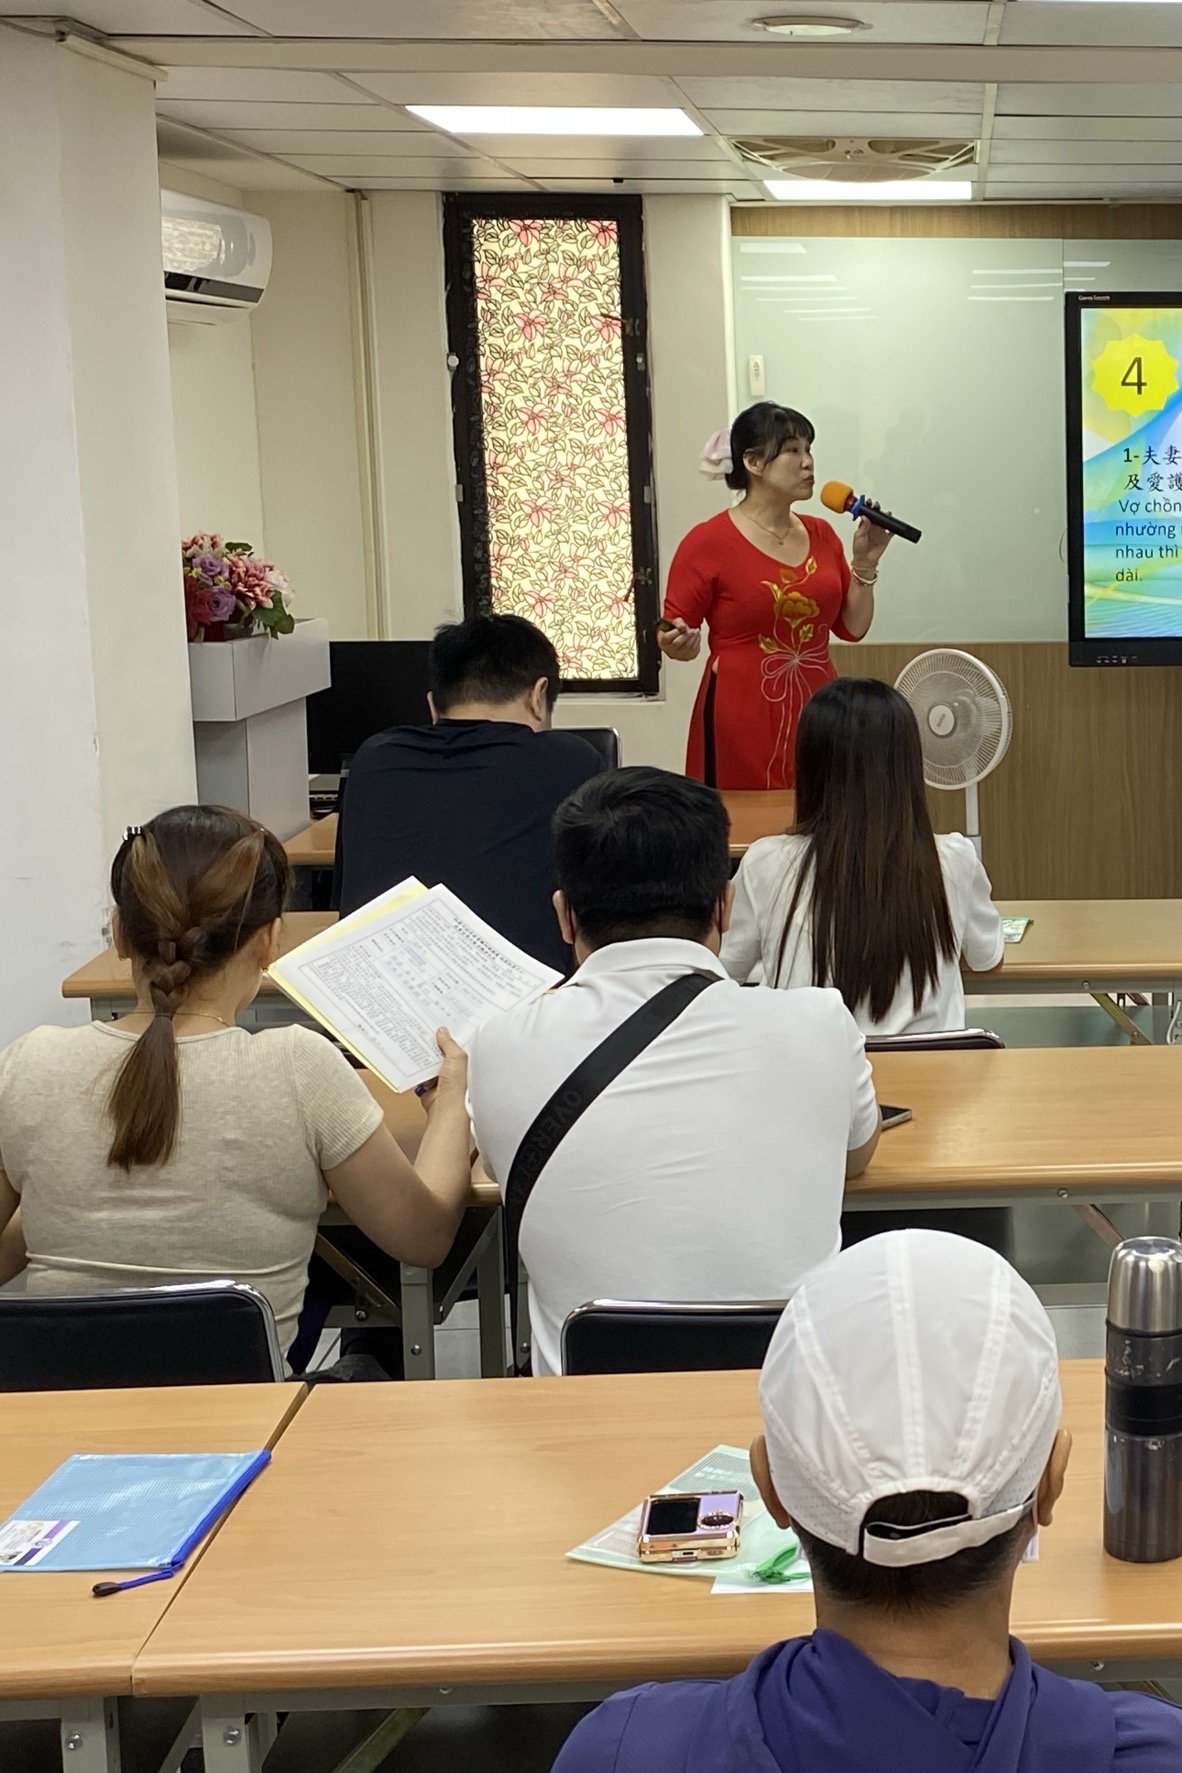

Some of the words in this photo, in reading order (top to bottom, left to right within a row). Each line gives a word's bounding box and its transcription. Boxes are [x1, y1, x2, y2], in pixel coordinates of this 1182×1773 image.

[1120, 356, 1148, 395] 4
[1118, 499, 1141, 515] Vợ
[1115, 521, 1176, 539] nhường
[1115, 545, 1154, 559] nhau
[1159, 544, 1179, 559] thì
